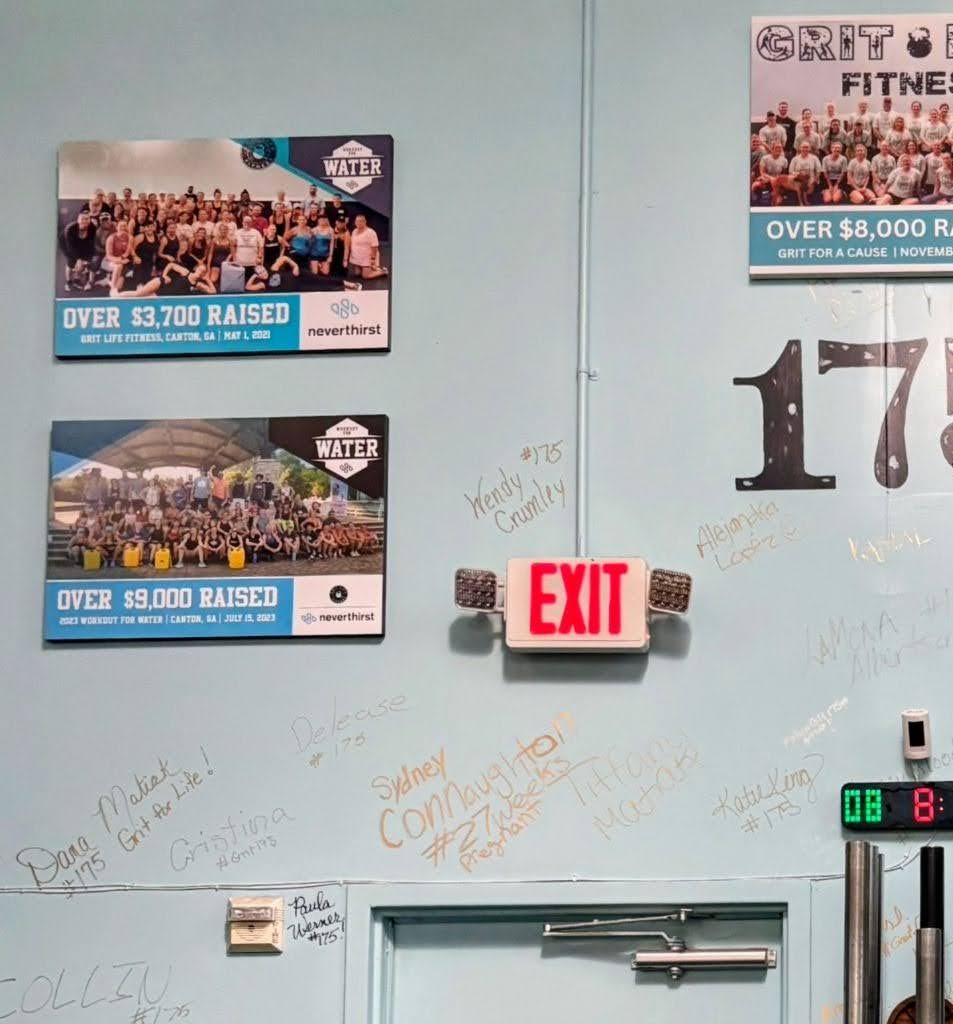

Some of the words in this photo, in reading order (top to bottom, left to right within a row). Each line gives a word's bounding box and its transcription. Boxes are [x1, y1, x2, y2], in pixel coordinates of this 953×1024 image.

[756, 24, 894, 62] GRIT
[323, 159, 382, 176] WATER
[767, 220, 832, 240] OVER
[839, 217, 926, 242] $8,000
[778, 248, 806, 259] GRIT
[809, 248, 833, 258] FOR
[835, 248, 844, 258] A
[847, 247, 888, 258] CAUSE
[63, 307, 120, 329] OVER
[131, 305, 201, 329] $3,700
[208, 303, 290, 325] RAISED
[103, 334, 123, 343] LIFE
[224, 331, 242, 340] MAY
[308, 323, 382, 337] neverthirst
[315, 439, 379, 459] WATER
[520, 440, 564, 466] #175
[465, 467, 522, 520] Wendy
[57, 589, 112, 610] OVER
[124, 588, 192, 611] $9,000
[199, 586, 278, 608] RAISED
[530, 562, 628, 636] EXIT
[80, 616, 119, 625] WORKOUT
[120, 615, 135, 624] FOR
[138, 615, 163, 624] WATER
[223, 614, 242, 623] JULY
[319, 611, 375, 623] neverthirst
[371, 747, 447, 804] Sydney
[844, 789, 882, 823] 08
[16, 836, 96, 890] Dana
